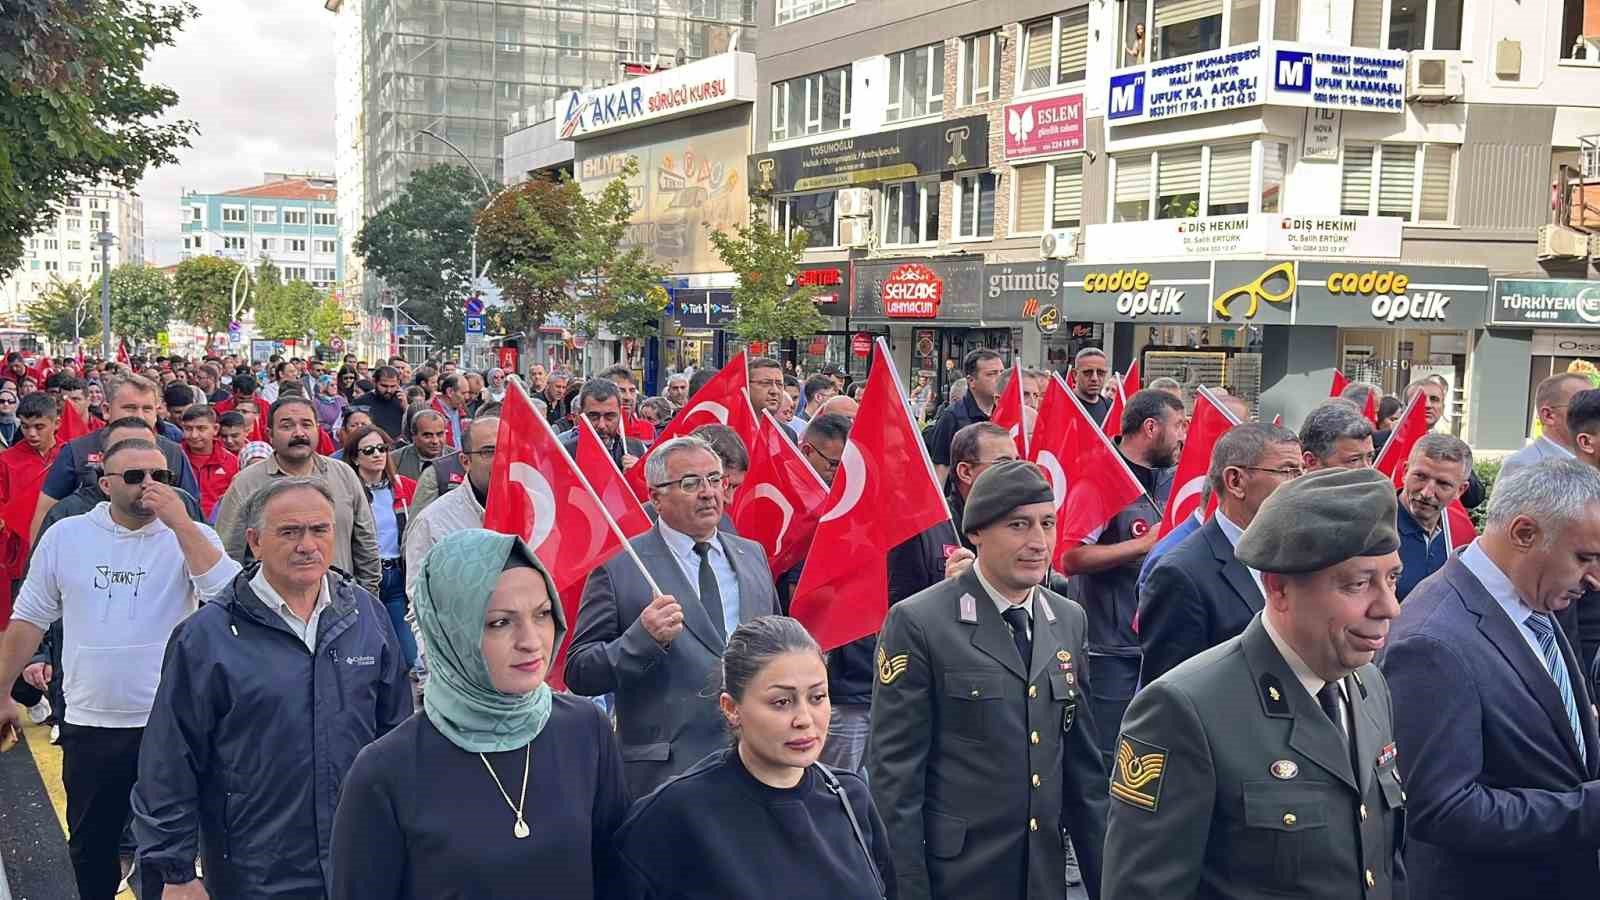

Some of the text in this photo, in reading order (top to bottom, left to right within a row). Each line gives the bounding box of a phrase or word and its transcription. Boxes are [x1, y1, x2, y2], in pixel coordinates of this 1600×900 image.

[1315, 77, 1342, 88] UFUK
[592, 86, 644, 127] AKAR
[648, 78, 726, 114] SÜRÜCÜ KURSU
[1151, 90, 1182, 105] UFUK
[1038, 104, 1078, 125] ESLEM
[811, 139, 854, 158] TOSUNOĞLU
[1293, 217, 1357, 233] DİŞ HEKİMİ
[989, 266, 1059, 297] gümüş
[1084, 268, 1150, 293] cadde
[1327, 270, 1409, 295] cadde
[887, 301, 933, 314] LAHMACUN
[1116, 286, 1185, 318] optik
[1370, 291, 1450, 322] optik
[1501, 293, 1576, 310] TÜRKİYEM
